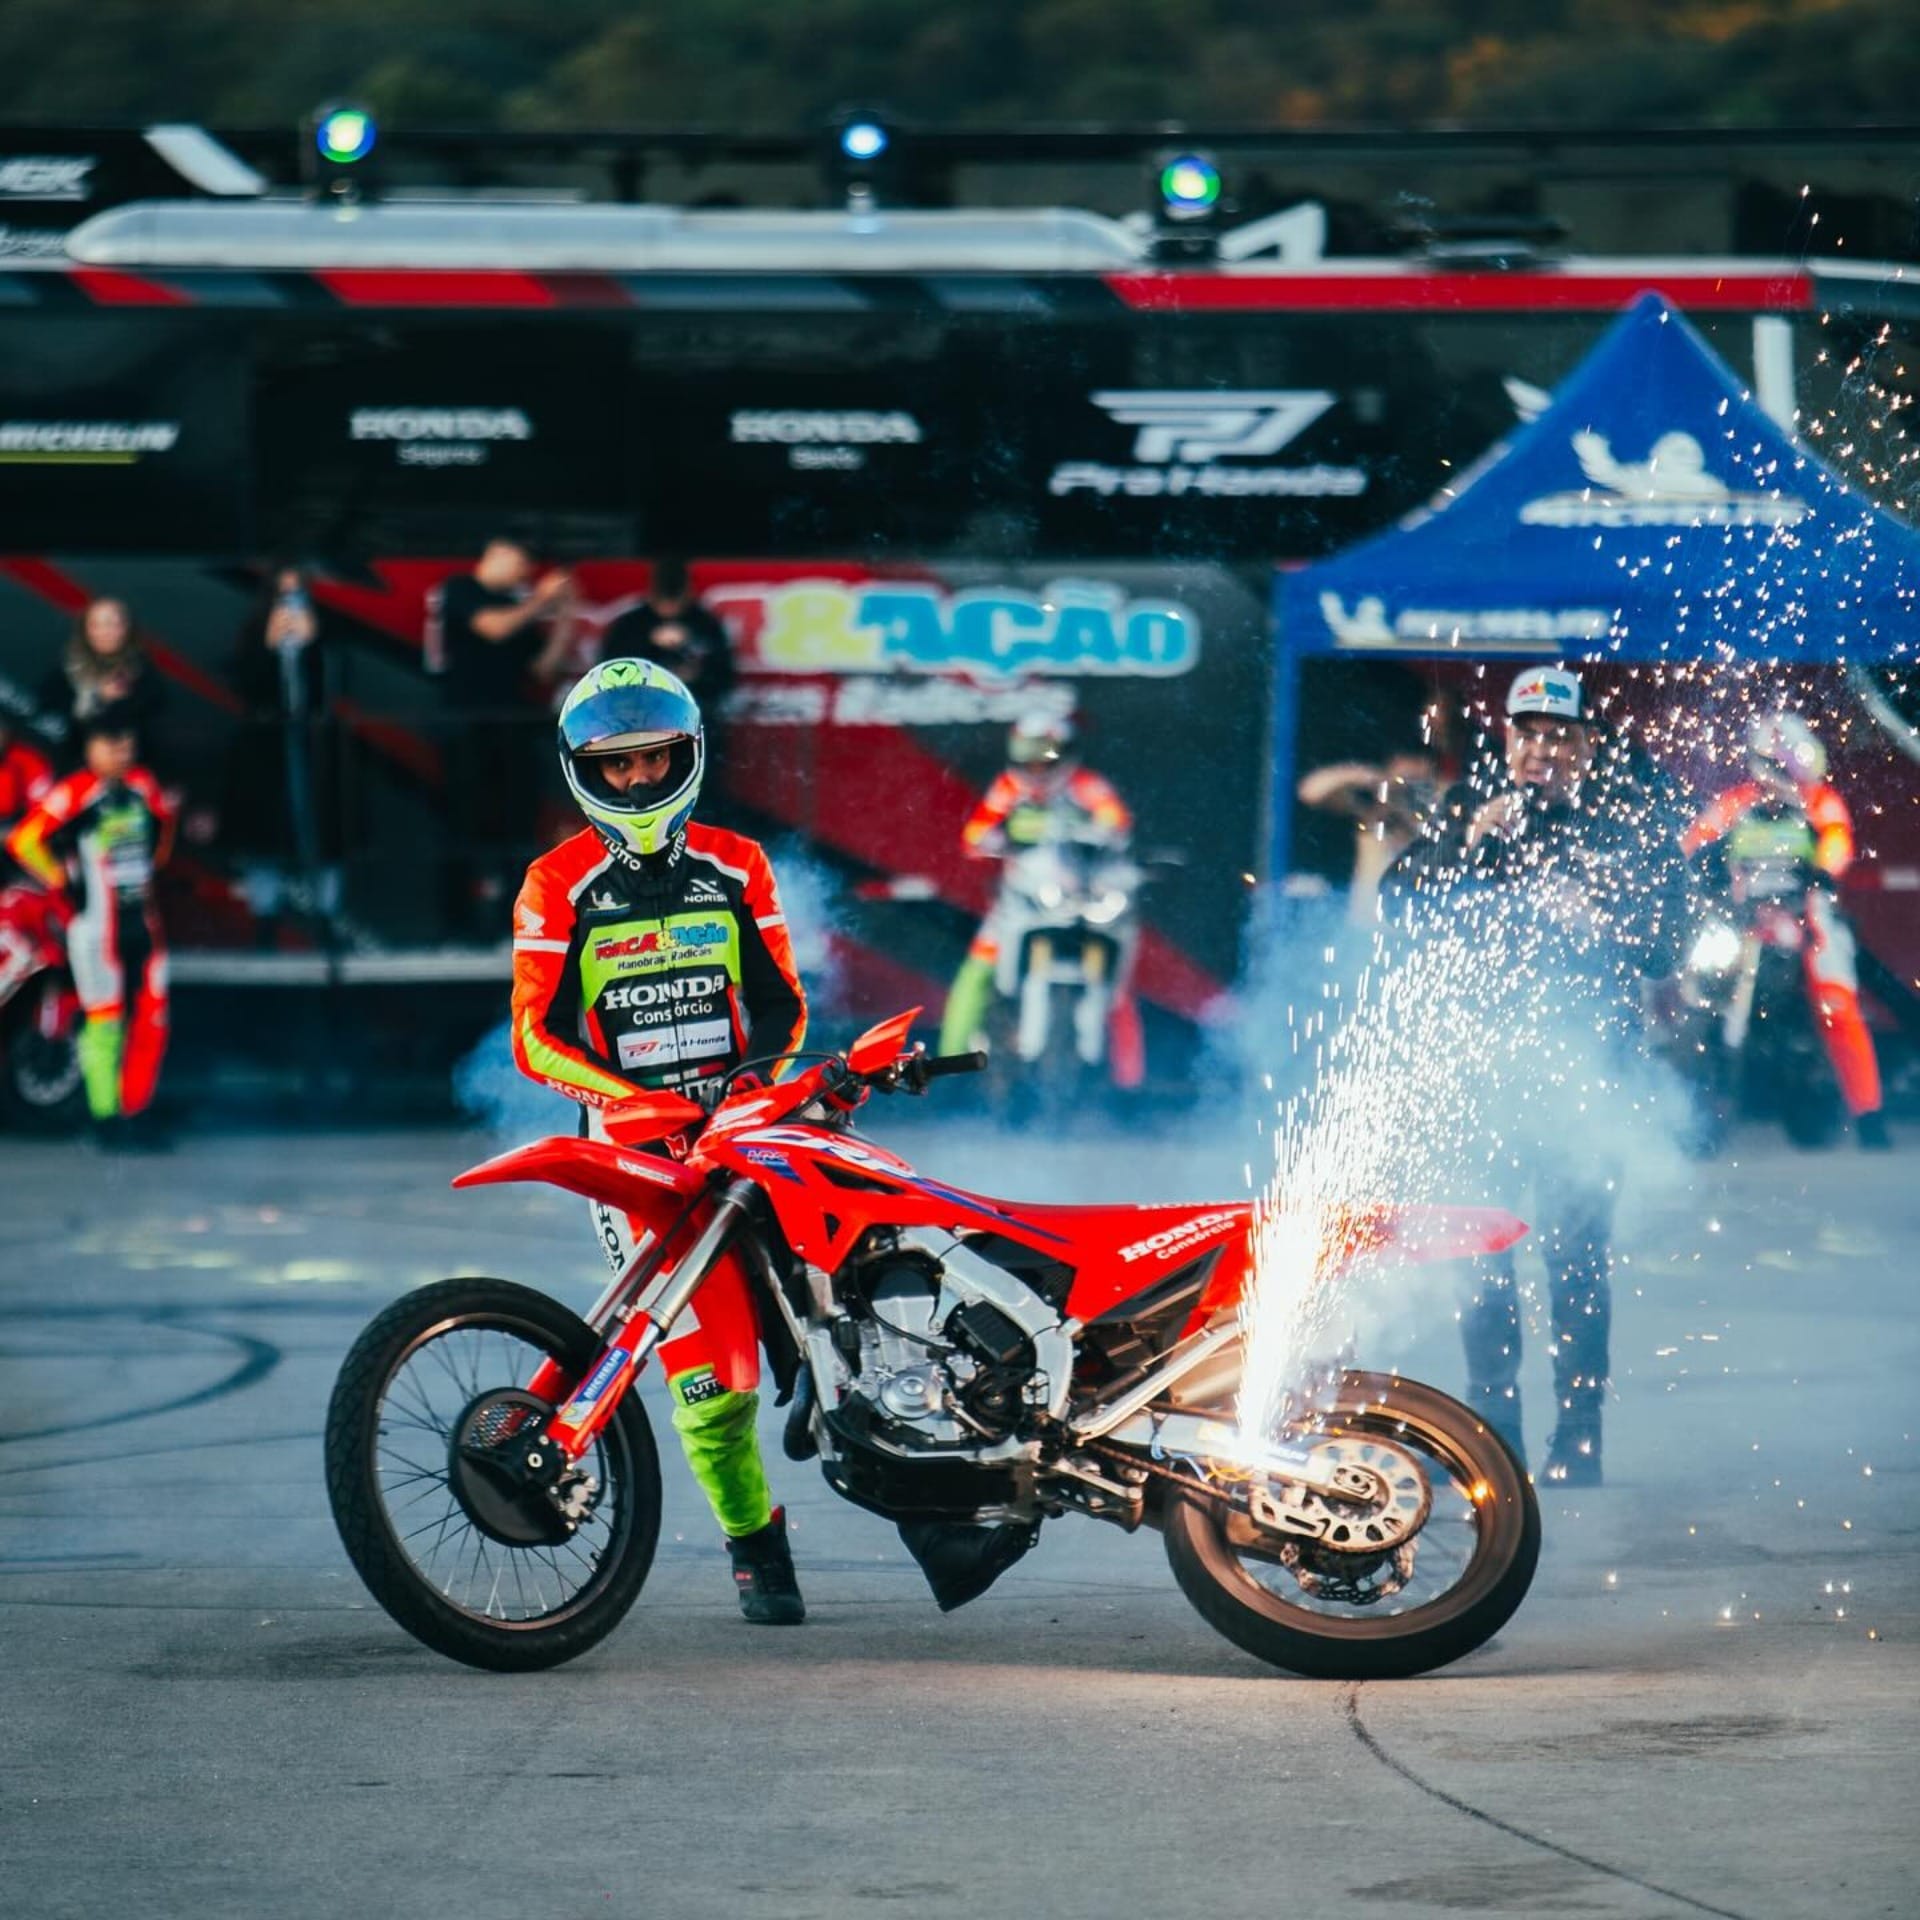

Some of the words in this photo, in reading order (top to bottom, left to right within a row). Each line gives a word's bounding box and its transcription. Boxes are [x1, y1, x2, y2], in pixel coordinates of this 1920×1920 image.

[351, 407, 532, 440] HONDA
[731, 410, 920, 443] HONDA
[618, 955, 666, 970] Manobras
[671, 946, 712, 962] Radicais
[603, 974, 725, 1010] HONDA
[683, 1378, 721, 1397] TUTT
